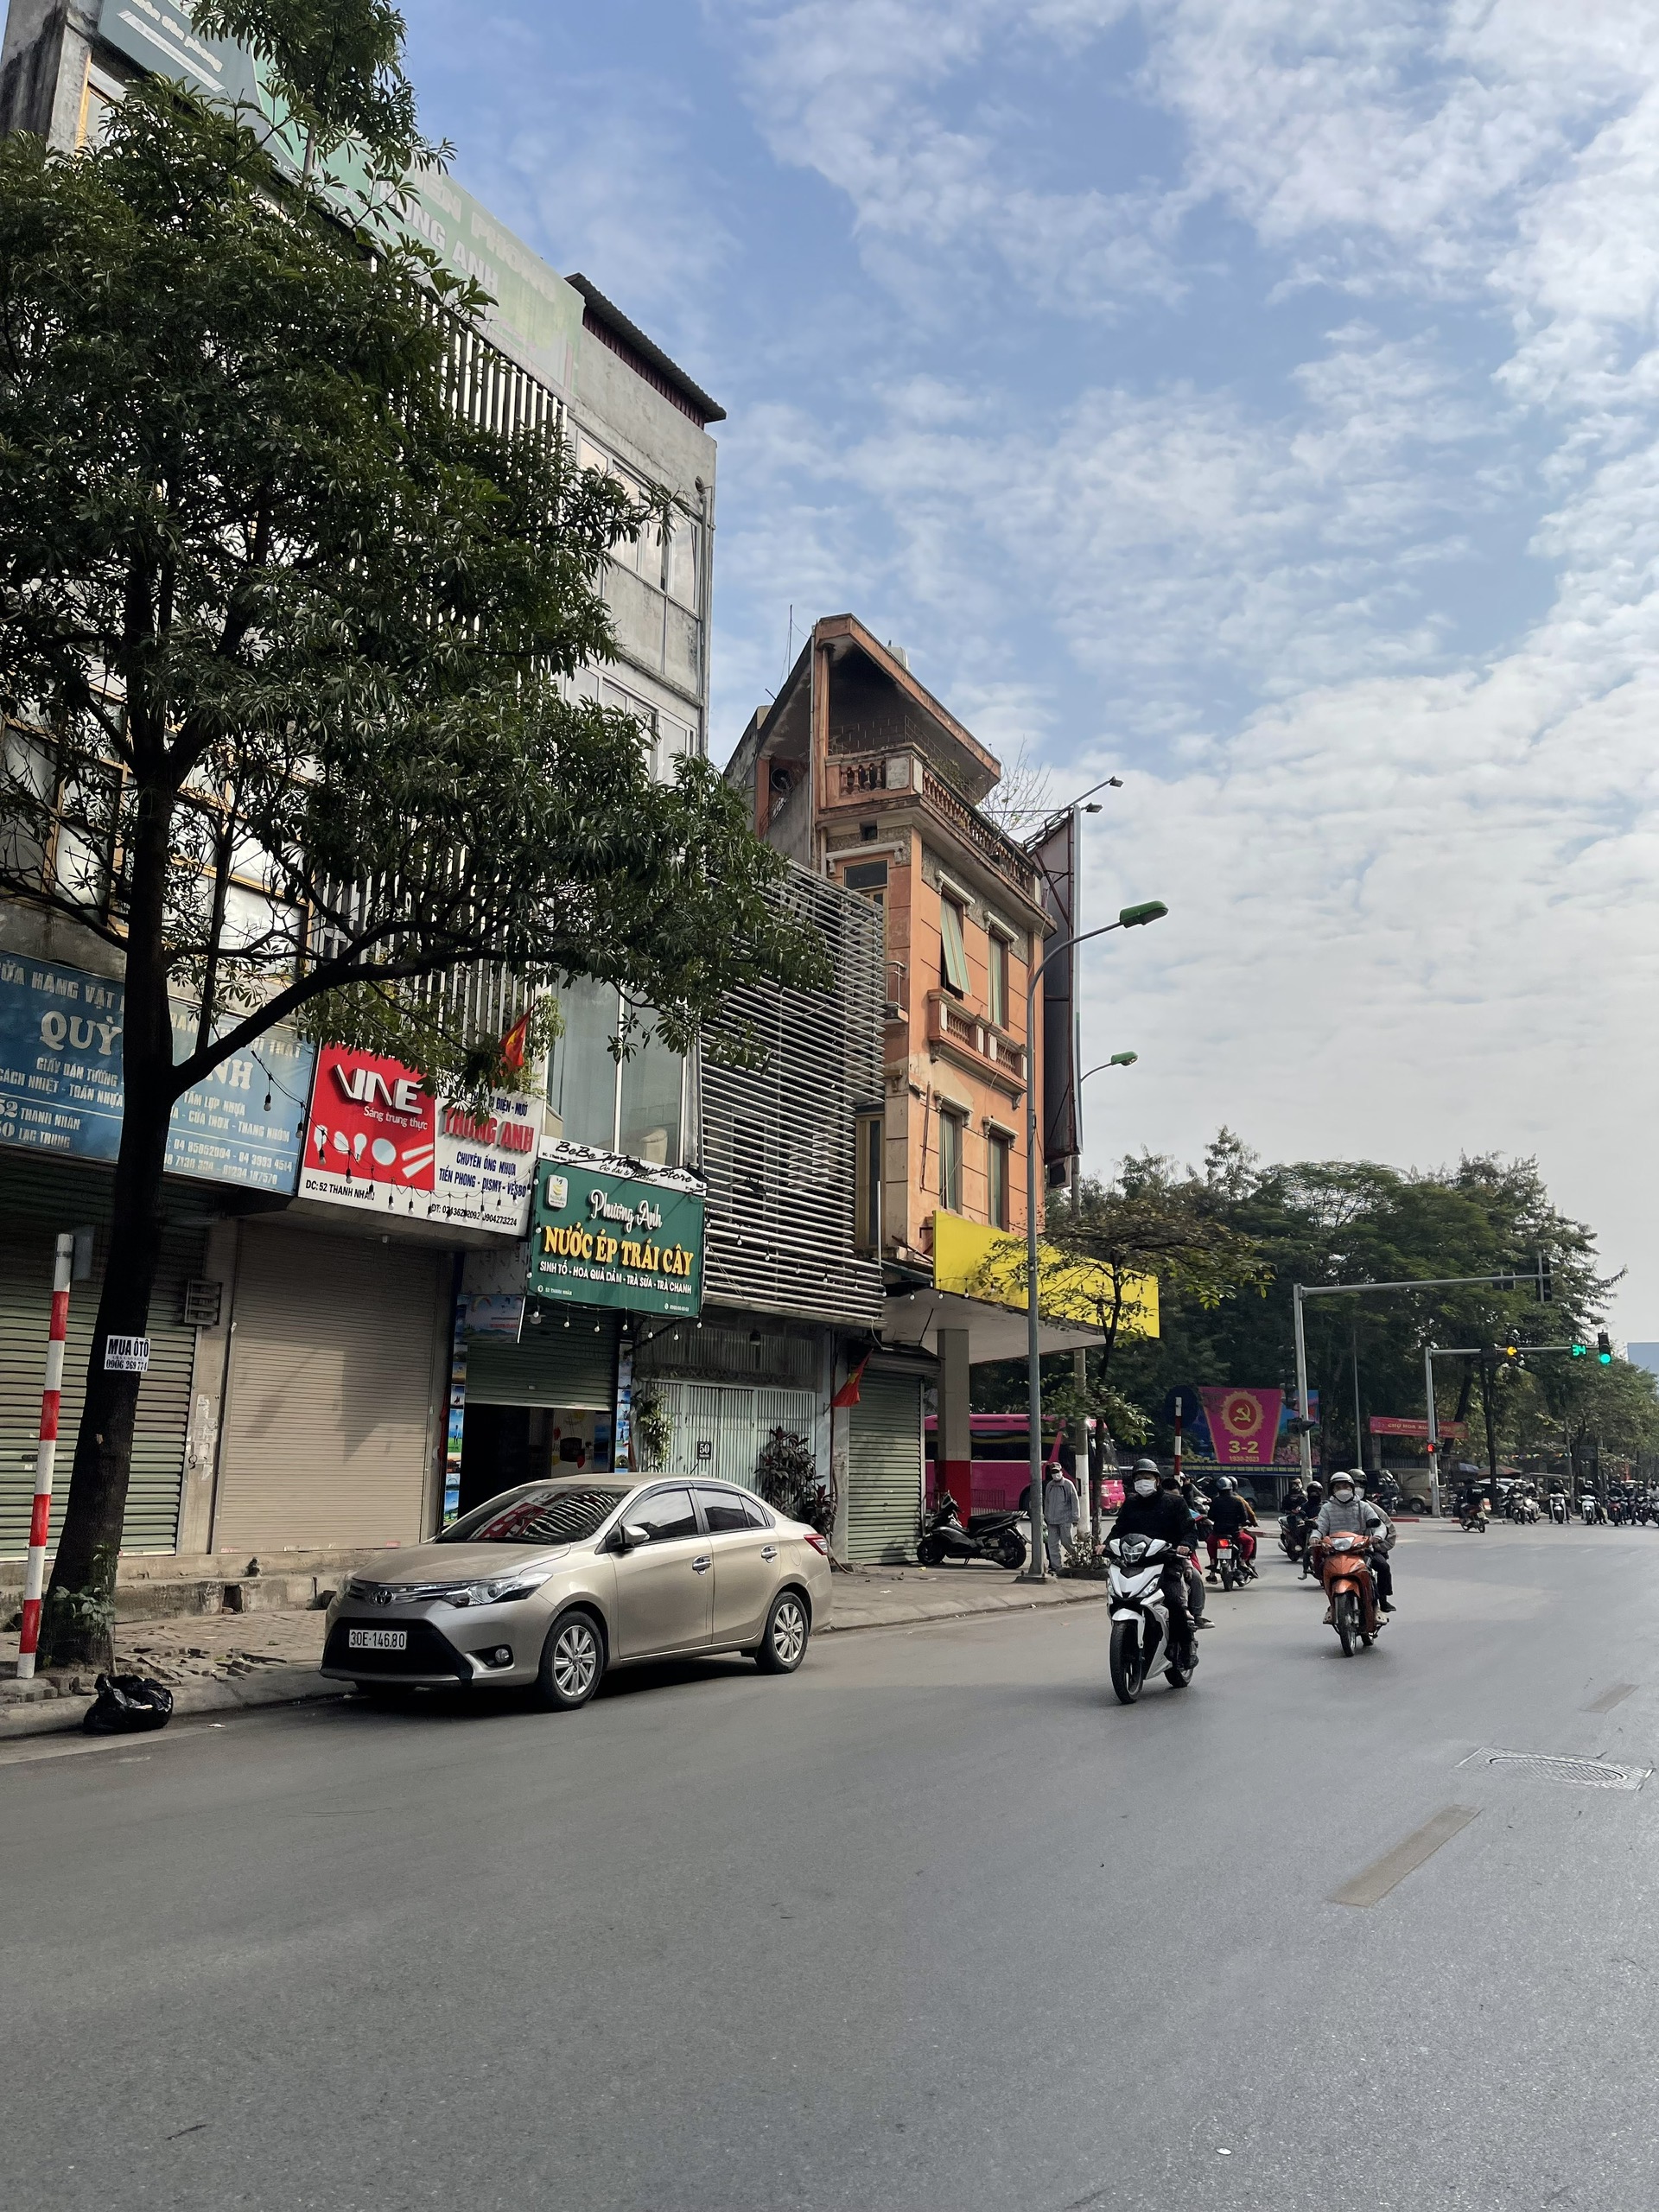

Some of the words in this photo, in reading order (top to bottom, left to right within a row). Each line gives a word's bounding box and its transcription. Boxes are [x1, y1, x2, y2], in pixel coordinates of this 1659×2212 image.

[452, 238, 498, 297] ANH
[0, 960, 24, 985] ỬA
[40, 1010, 123, 1056] QUỲ
[21, 1108, 52, 1124] THANH
[363, 1106, 385, 1122] Sáng
[385, 1111, 408, 1128] trung
[410, 1117, 428, 1131] thực
[40, 1131, 71, 1148] TRUNG
[500, 1122, 534, 1152] ANH
[456, 1151, 482, 1169] CHUYÊN
[484, 1154, 497, 1172] ỐNG
[499, 1160, 516, 1178] NHỰA
[319, 1182, 328, 1192] 52
[329, 1183, 353, 1197] THANH
[454, 1171, 476, 1188] PHONG
[482, 1177, 502, 1193] DISMY
[635, 1199, 663, 1230] Anh
[544, 1222, 593, 1259] NƯỚC
[595, 1229, 617, 1263] ÉP
[621, 1238, 659, 1271] TRÁI
[663, 1243, 695, 1276] CÂY
[540, 1261, 556, 1274] SINH
[558, 1259, 568, 1274] TỐ
[573, 1265, 588, 1278] HOA
[626, 1274, 639, 1286] TRÀ
[657, 1279, 668, 1291] TRÀ
[670, 1281, 692, 1294] CHANH
[108, 1338, 131, 1356] MUA
[134, 1338, 149, 1357] ÔTÔ
[699, 1443, 710, 1454] 50
[1229, 1440, 1259, 1454] 3-2
